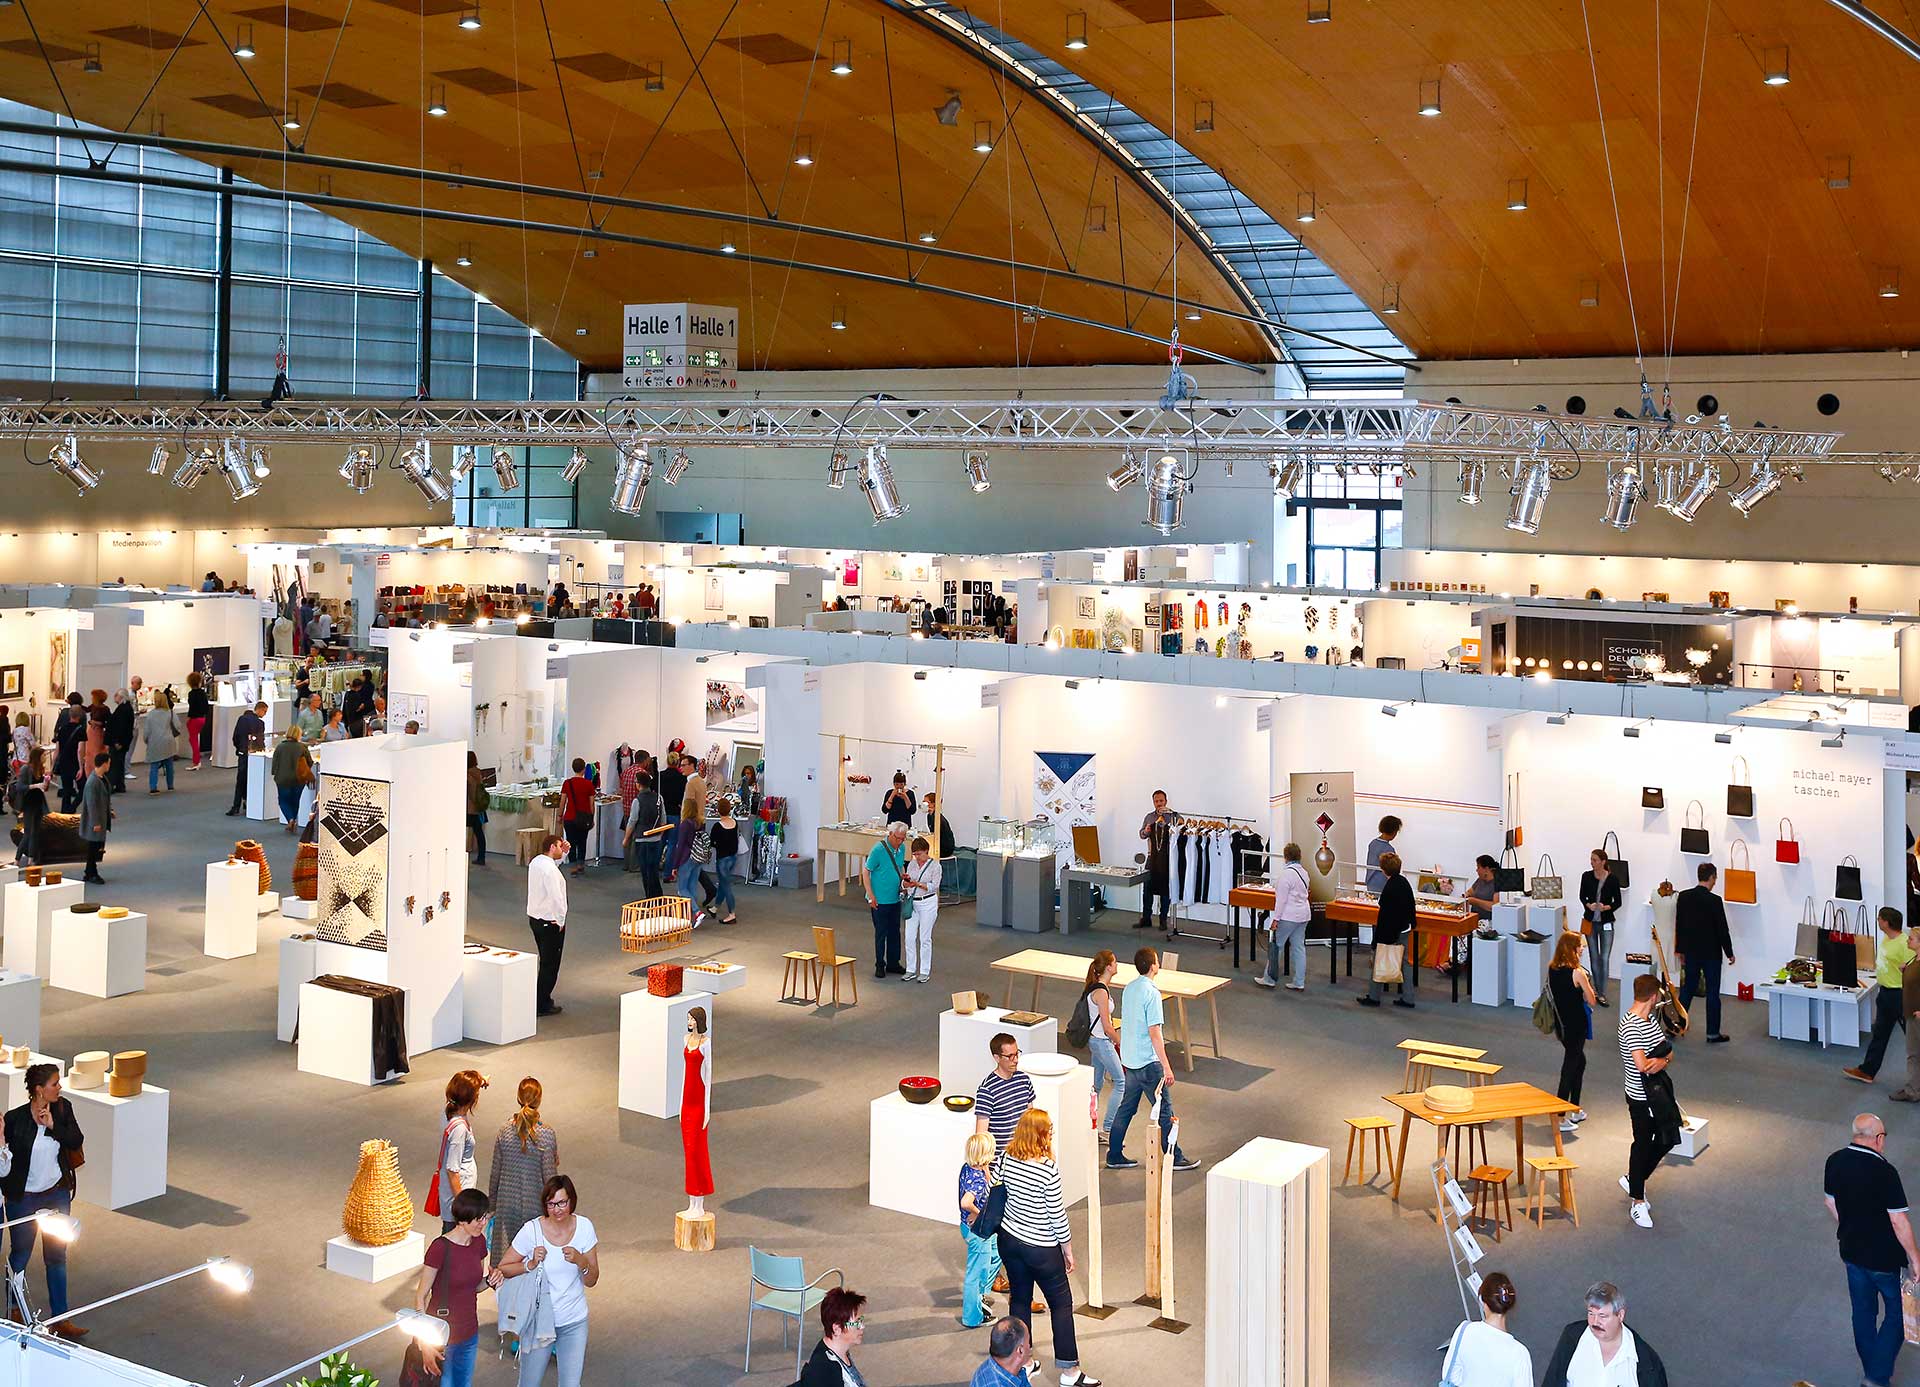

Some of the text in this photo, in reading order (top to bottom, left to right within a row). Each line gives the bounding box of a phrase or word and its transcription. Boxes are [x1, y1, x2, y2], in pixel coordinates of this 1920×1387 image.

[628, 315, 682, 335] Halle 1
[690, 315, 735, 337] Halle 1
[1793, 768, 1872, 787] michael mayer
[1794, 784, 1840, 798] taschen
